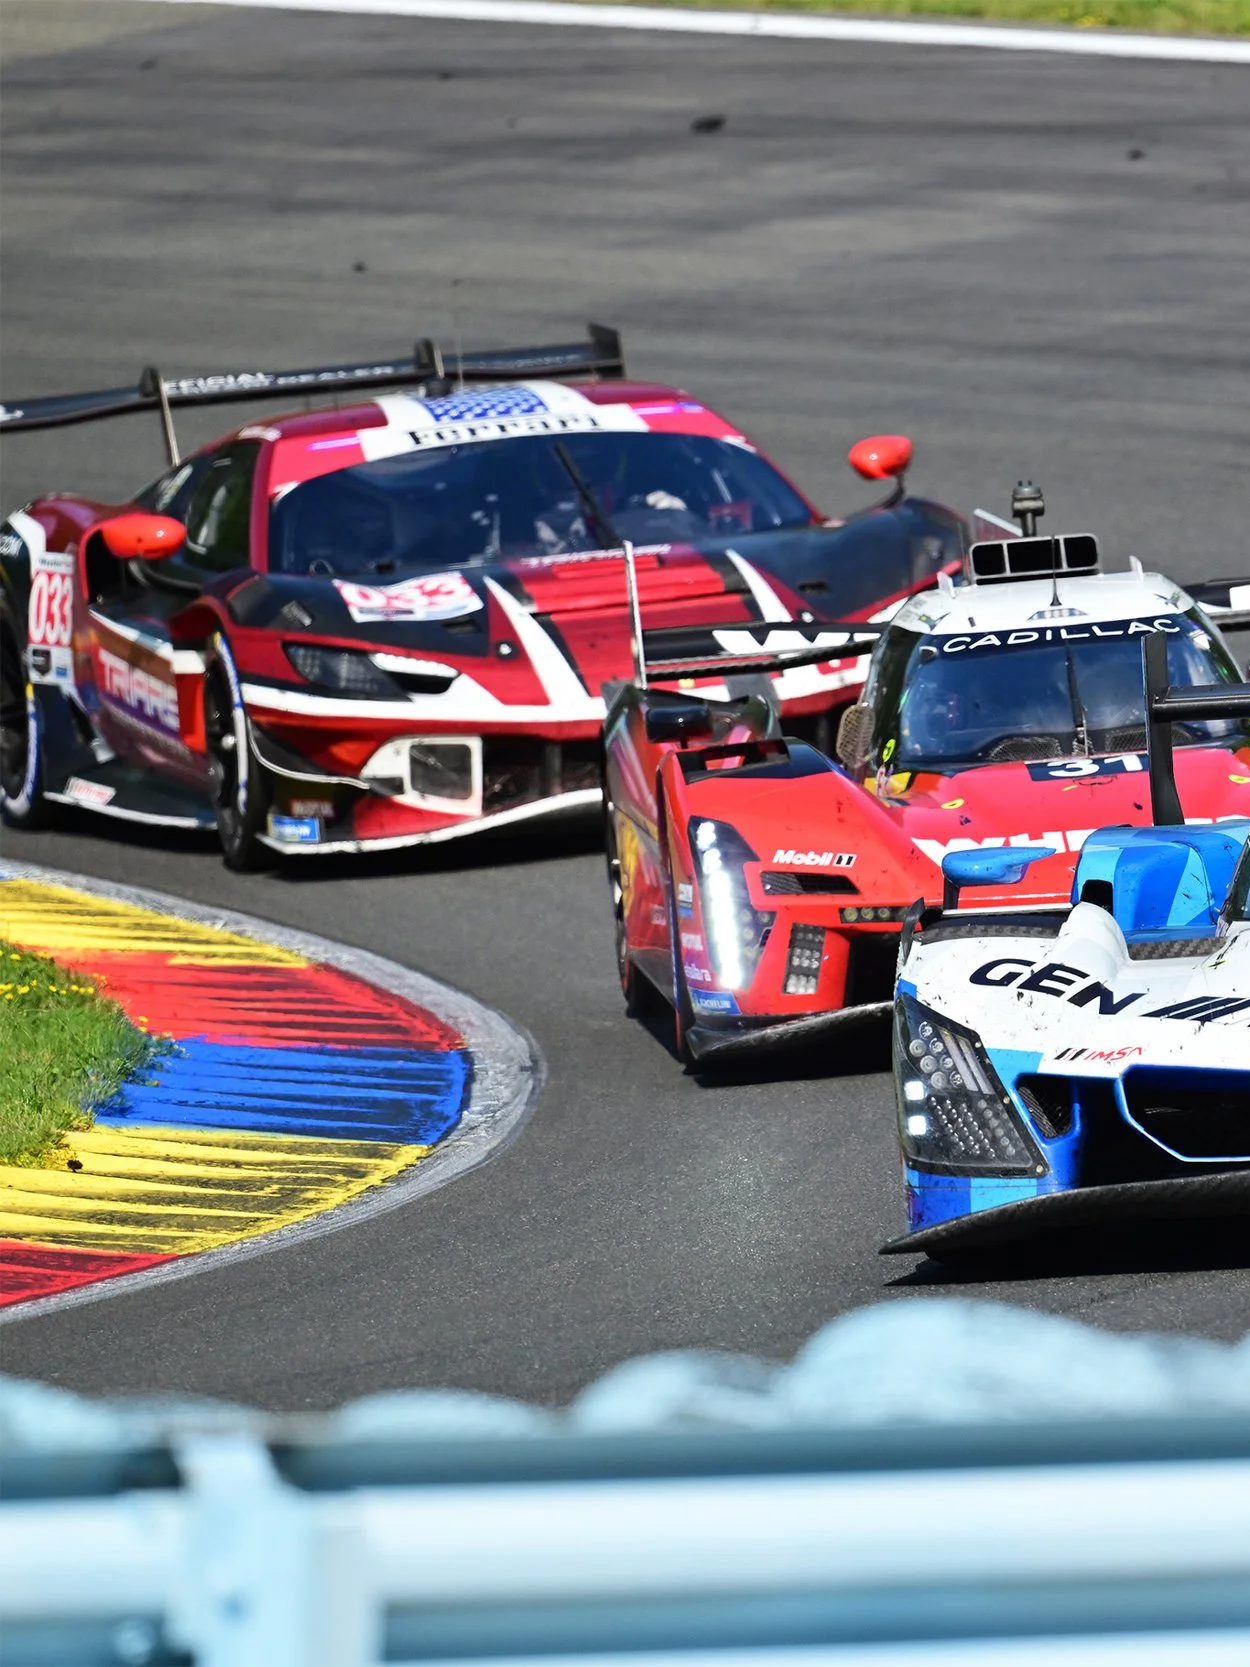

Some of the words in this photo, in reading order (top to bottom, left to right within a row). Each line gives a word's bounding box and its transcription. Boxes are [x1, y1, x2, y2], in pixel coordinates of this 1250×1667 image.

[405, 413, 604, 447] Ferrari
[28, 571, 73, 645] 033
[942, 618, 1180, 654] CADILLAC
[1048, 754, 1143, 777] 31
[772, 849, 833, 866] Mobil
[969, 958, 1149, 1016] GEN
[1083, 1046, 1143, 1062] IMSA
